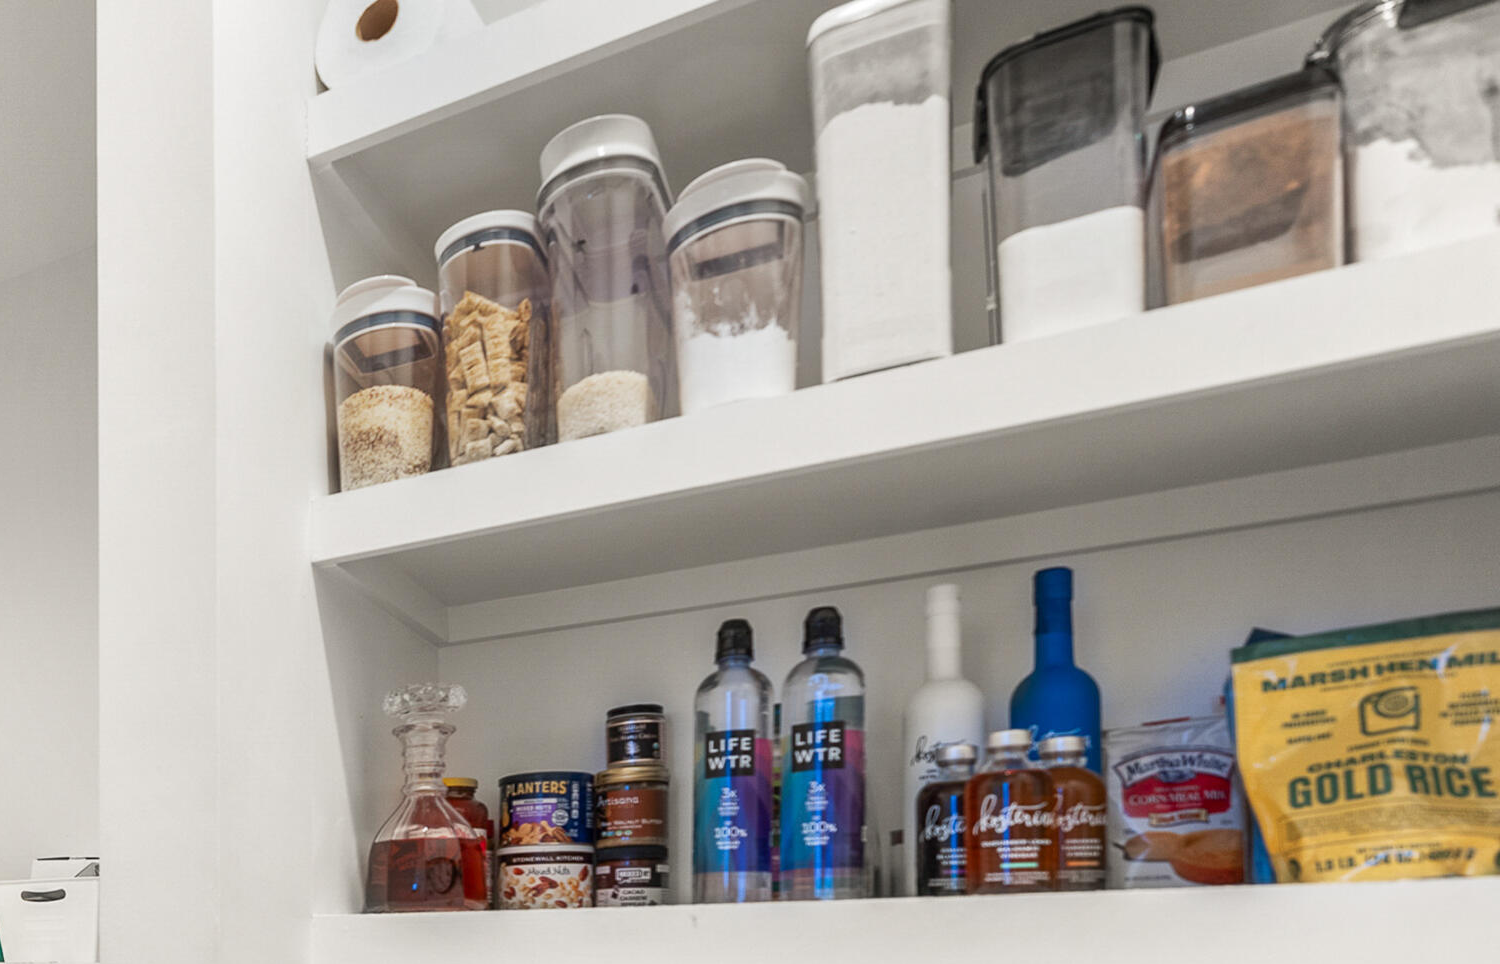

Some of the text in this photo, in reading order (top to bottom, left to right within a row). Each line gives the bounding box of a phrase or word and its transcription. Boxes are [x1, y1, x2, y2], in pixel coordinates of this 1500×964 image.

[1261, 666, 1369, 692] MARSH
[708, 737, 752, 753] LIFE
[794, 729, 841, 746] LIFE
[708, 756, 752, 770] WTR
[794, 747, 842, 763] WTR
[1307, 749, 1470, 773] CHARLESTON
[506, 780, 568, 796] PLANTERS
[1288, 763, 1498, 808] GOLD RICE
